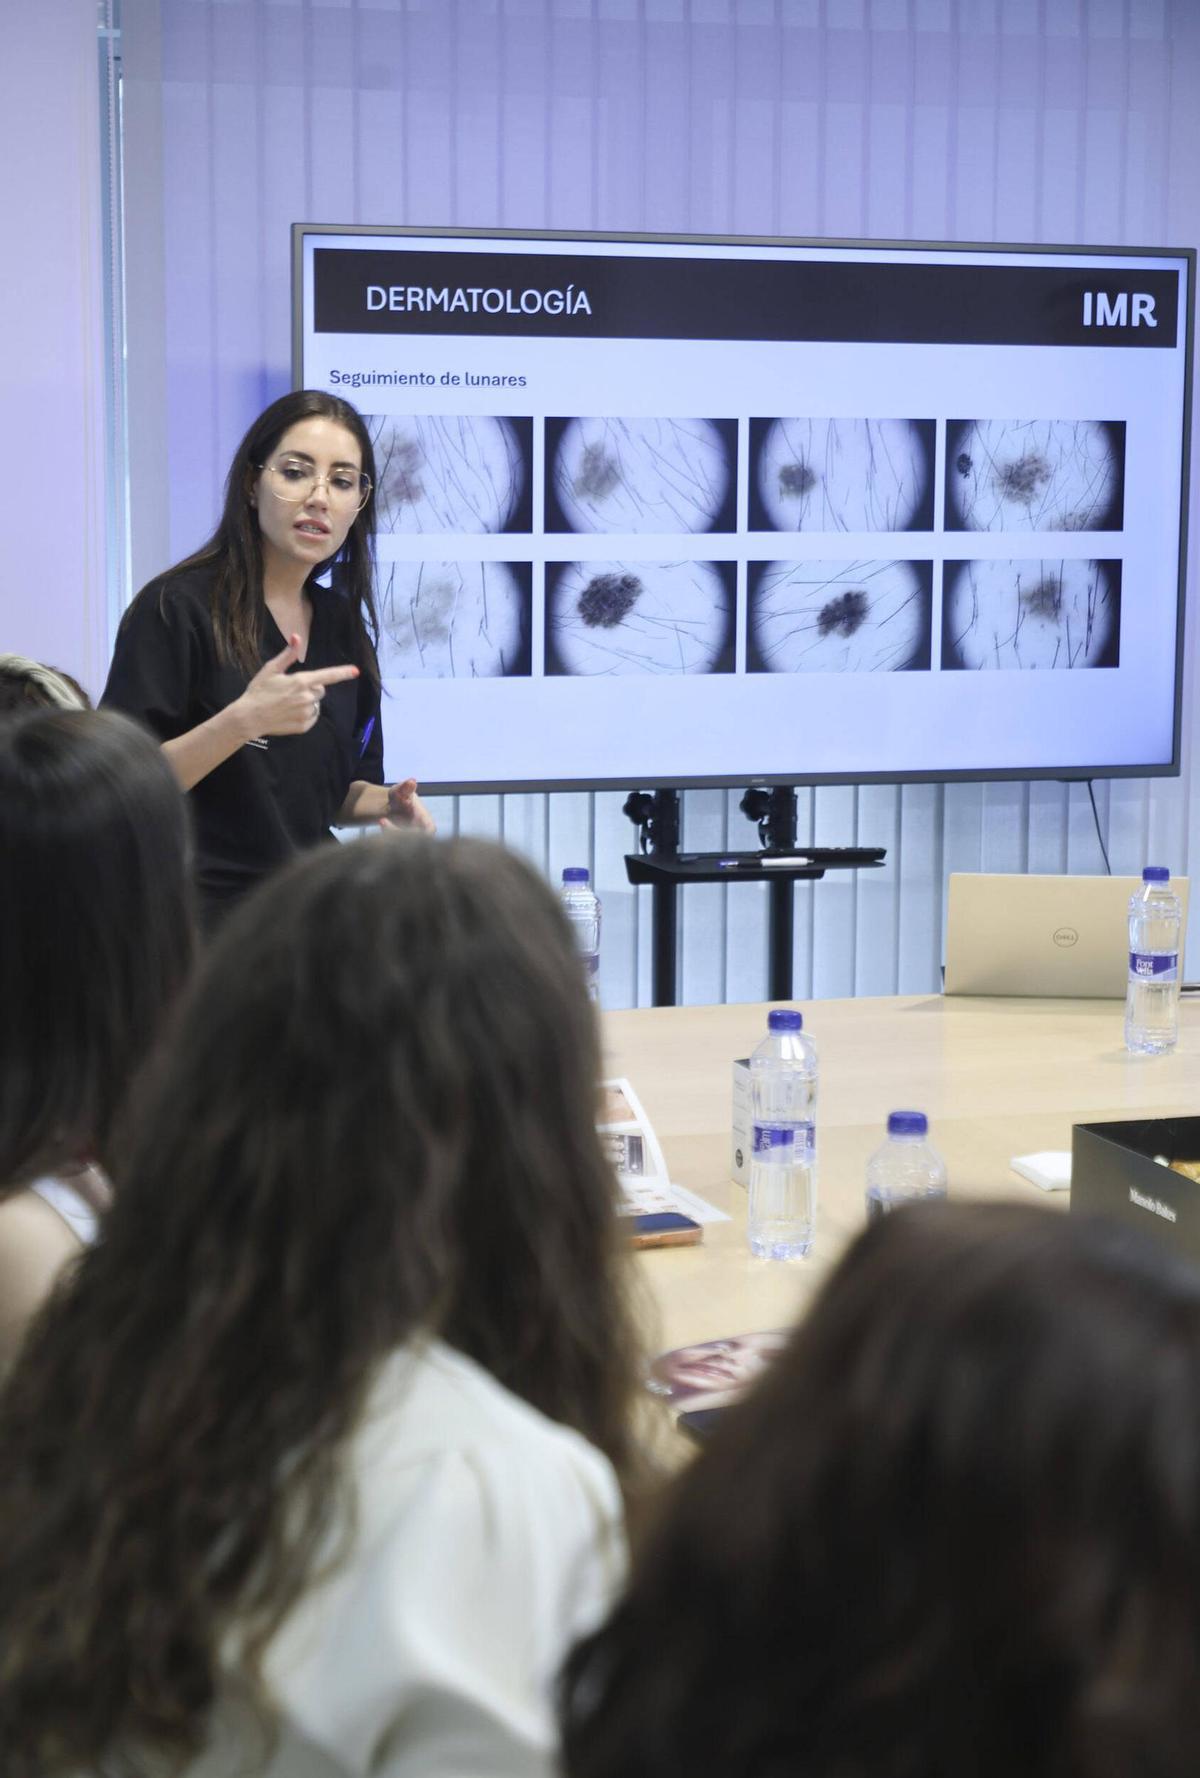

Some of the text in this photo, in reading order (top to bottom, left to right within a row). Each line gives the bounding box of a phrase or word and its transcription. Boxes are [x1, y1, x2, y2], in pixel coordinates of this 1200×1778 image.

[366, 284, 592, 315] DERMATOLOGÍA
[1083, 292, 1158, 327] IMR
[329, 370, 527, 388] Seguimiento de lunares
